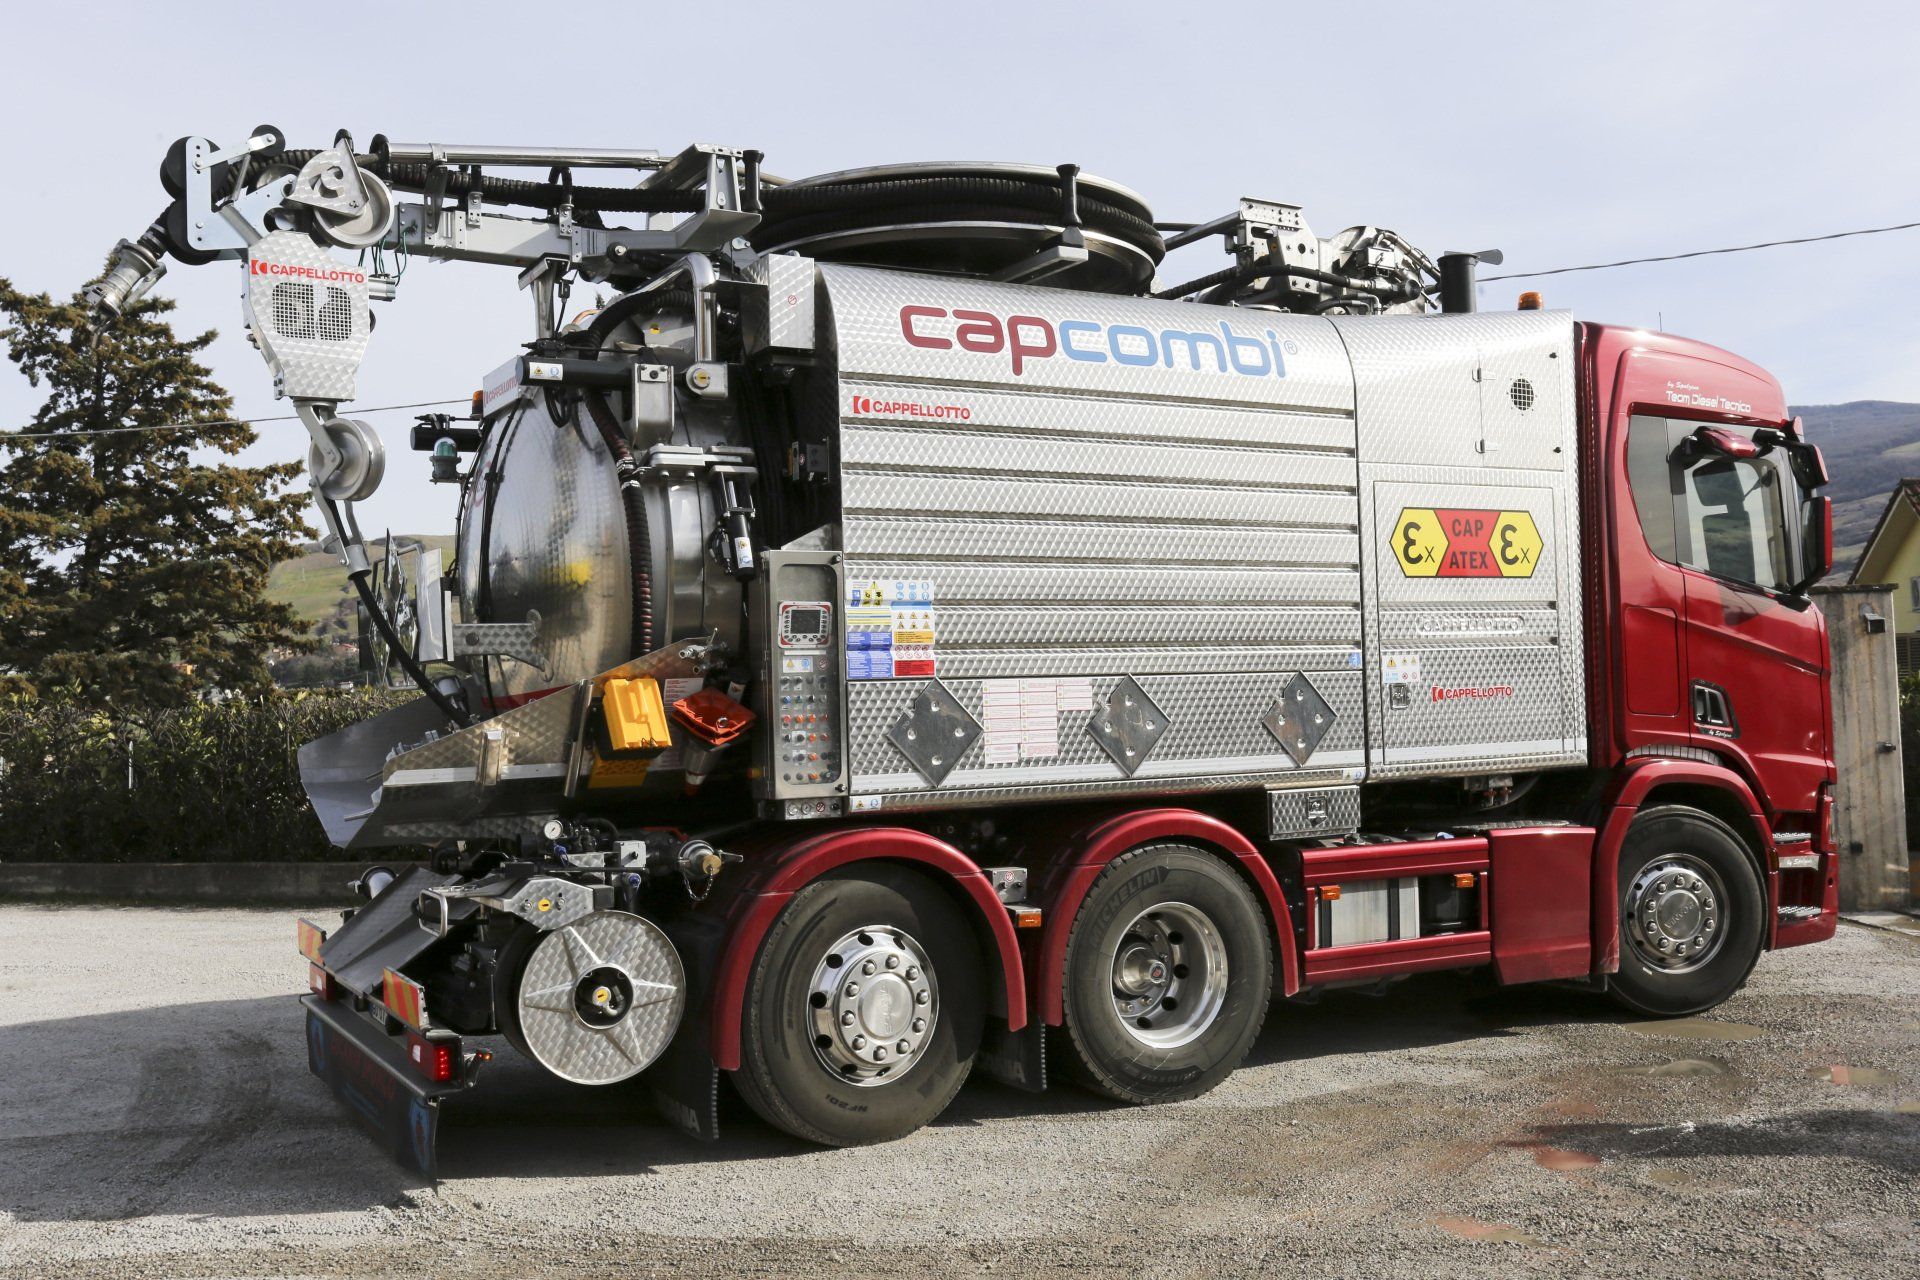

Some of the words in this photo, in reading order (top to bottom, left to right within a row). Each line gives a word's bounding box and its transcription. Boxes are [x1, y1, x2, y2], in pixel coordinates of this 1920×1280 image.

[270, 264, 364, 283] CAPPELLOTTO
[1666, 391, 1690, 405] Team
[1691, 394, 1718, 408] Diesel
[873, 400, 971, 420] CAPPELLOTTO
[1452, 518, 1484, 537] CAP
[1449, 551, 1488, 569] ATEX
[1445, 686, 1512, 699] CAPPELLOTTO
